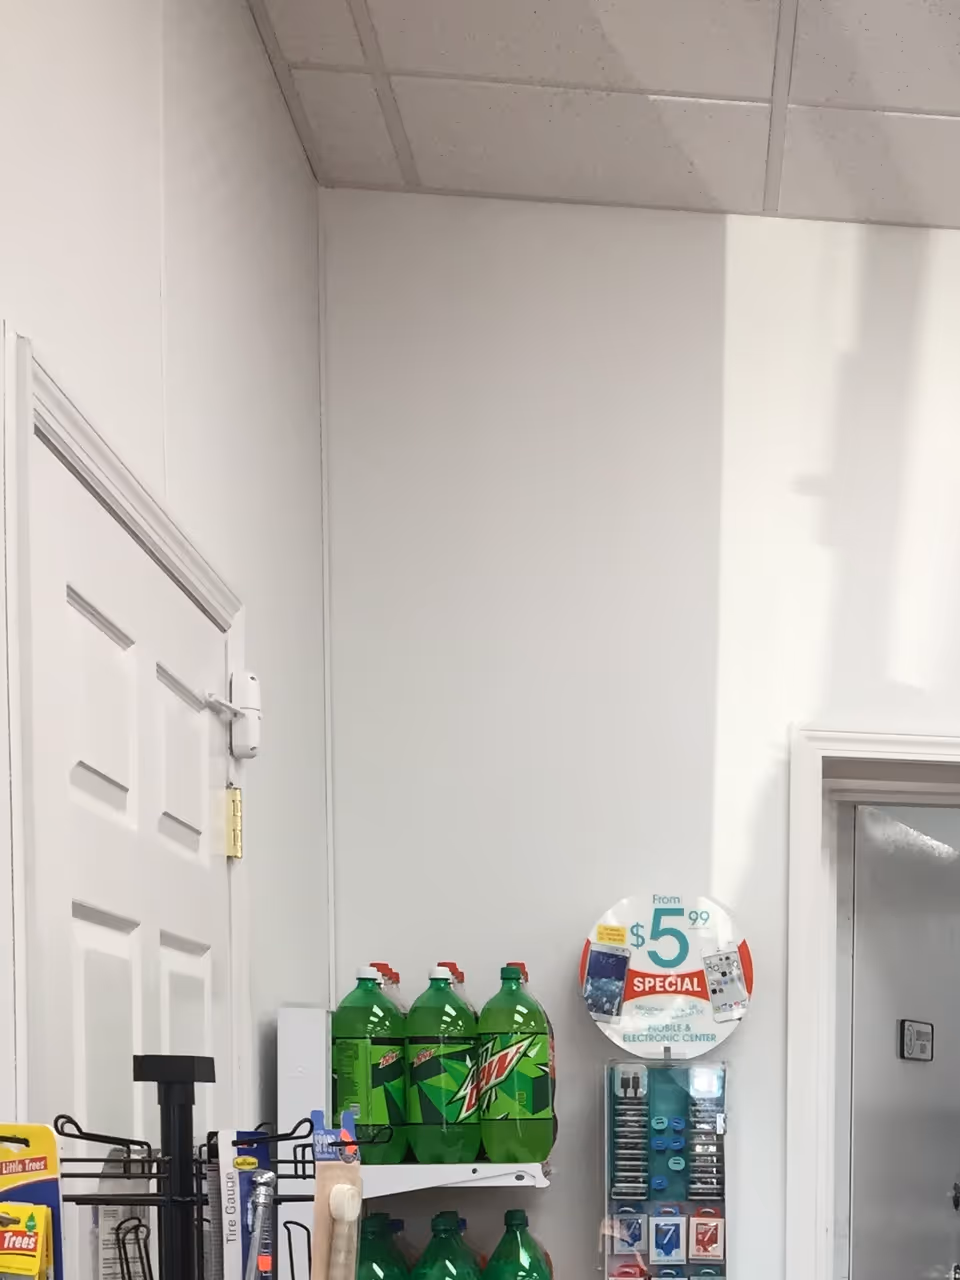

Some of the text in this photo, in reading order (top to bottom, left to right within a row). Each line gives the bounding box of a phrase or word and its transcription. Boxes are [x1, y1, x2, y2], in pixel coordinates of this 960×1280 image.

[652, 894, 681, 904] From
[632, 976, 702, 992] SPECIAL
[622, 1034, 717, 1043] ELECTRONIC CENTER
[2, 1159, 45, 1174] Little Trees
[226, 1221, 237, 1244] Tire
[3, 1231, 37, 1250] Trees
